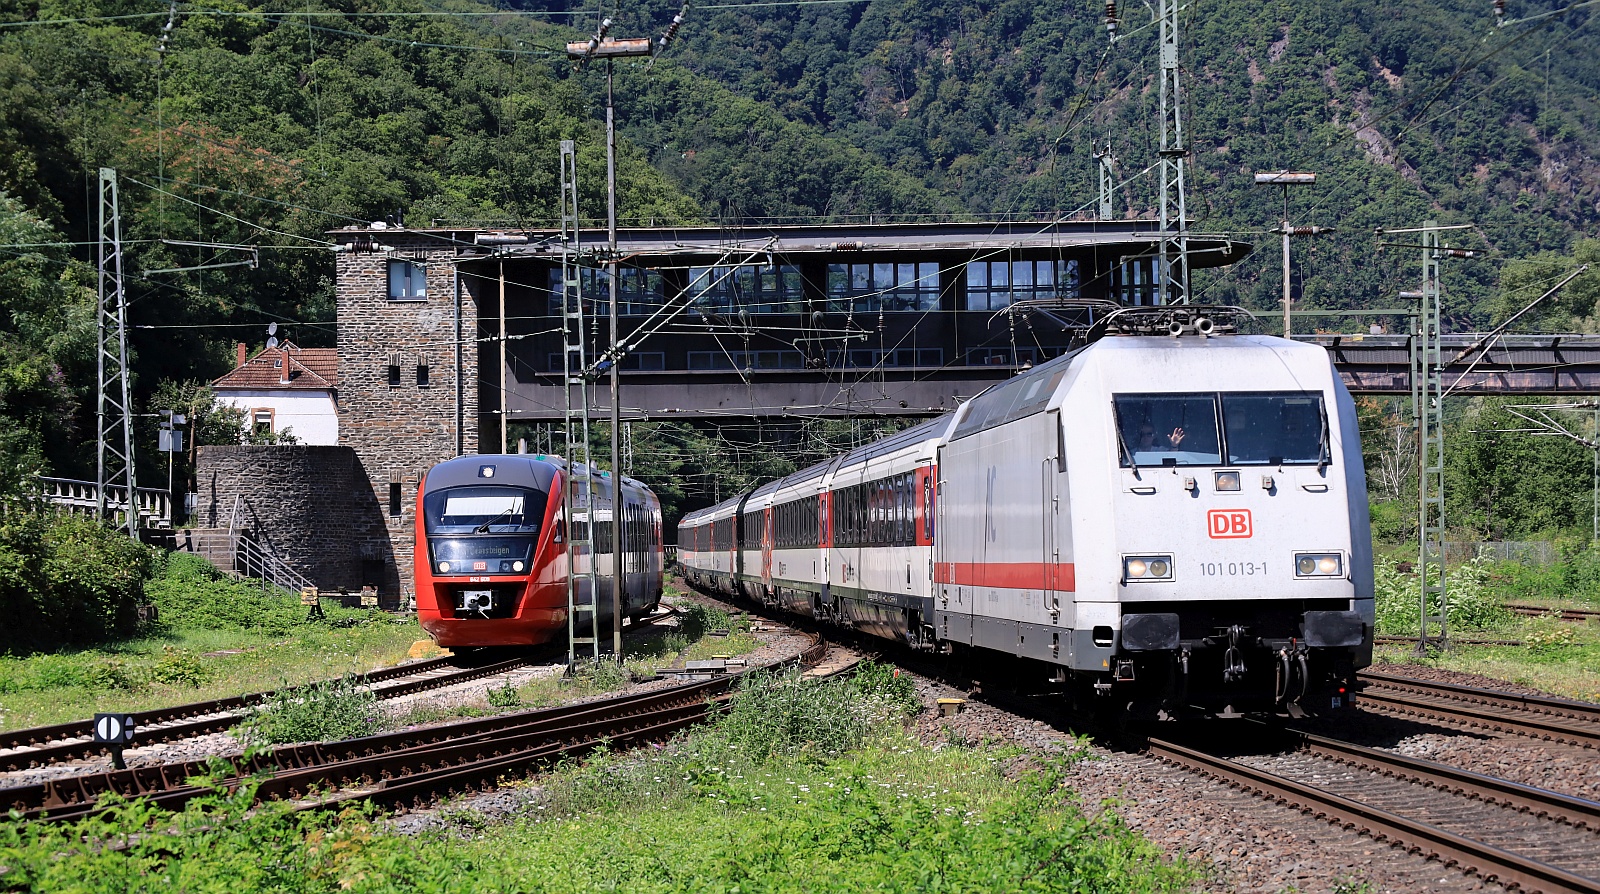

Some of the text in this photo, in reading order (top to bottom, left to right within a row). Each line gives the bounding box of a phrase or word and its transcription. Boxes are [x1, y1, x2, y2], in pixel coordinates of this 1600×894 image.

[1212, 513, 1248, 534] DB
[1200, 561, 1267, 576] 101 013-1
